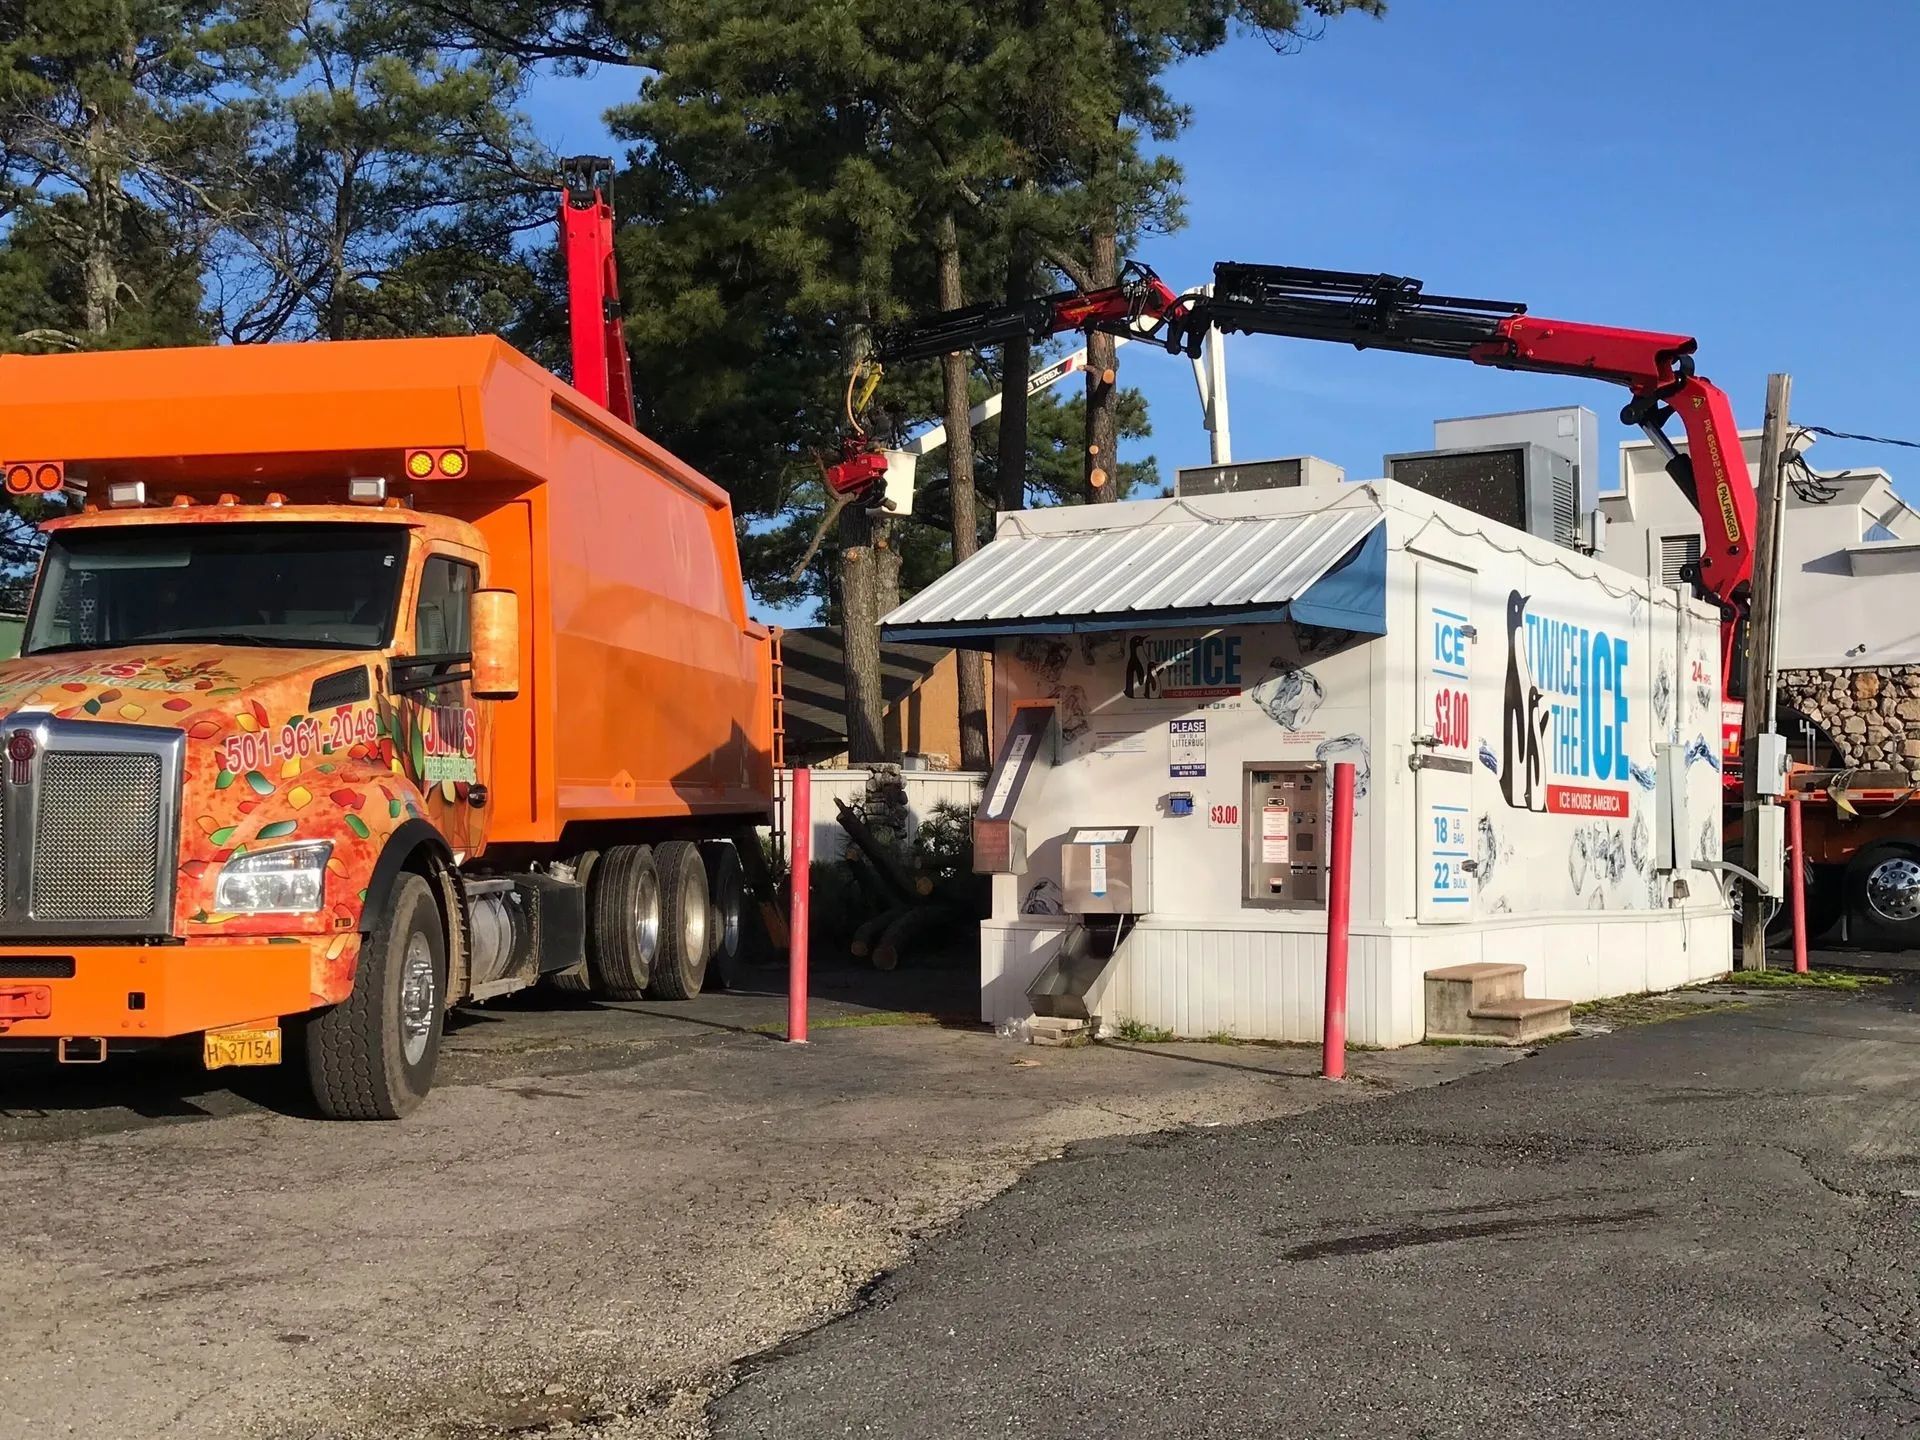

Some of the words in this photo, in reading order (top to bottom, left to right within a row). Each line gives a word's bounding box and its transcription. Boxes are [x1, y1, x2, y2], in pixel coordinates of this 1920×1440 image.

[1703, 419, 1712, 433] PK
[1707, 434, 1720, 467] 65002
[1718, 485, 1738, 539] PALFINGER
[1145, 639, 1191, 661] TWICE
[1435, 622, 1465, 667] ICE
[1525, 614, 1578, 697] TWICE
[1192, 636, 1241, 685] ICE
[1692, 660, 1702, 682] 24
[1167, 664, 1191, 686] THE
[1580, 628, 1629, 781] ICE
[423, 704, 476, 758] JIM'S
[1171, 721, 1205, 732] PLEASE
[1435, 688, 1469, 750] $3.00
[226, 707, 377, 774] 501-961-2048
[1172, 738, 1205, 748] LITTERBUG
[1551, 704, 1578, 776] THE
[1211, 805, 1238, 825] $3.00
[1559, 791, 1570, 808] ICE
[1571, 791, 1592, 810] HOUSE
[1592, 793, 1620, 812] AMERICA
[1434, 816, 1448, 843] 18
[1453, 818, 1460, 830] LB
[1453, 832, 1465, 844] BAG
[1434, 862, 1449, 889] 22
[1453, 878, 1467, 889] BULK
[206, 1043, 219, 1062] H
[228, 1040, 272, 1061] 37154
